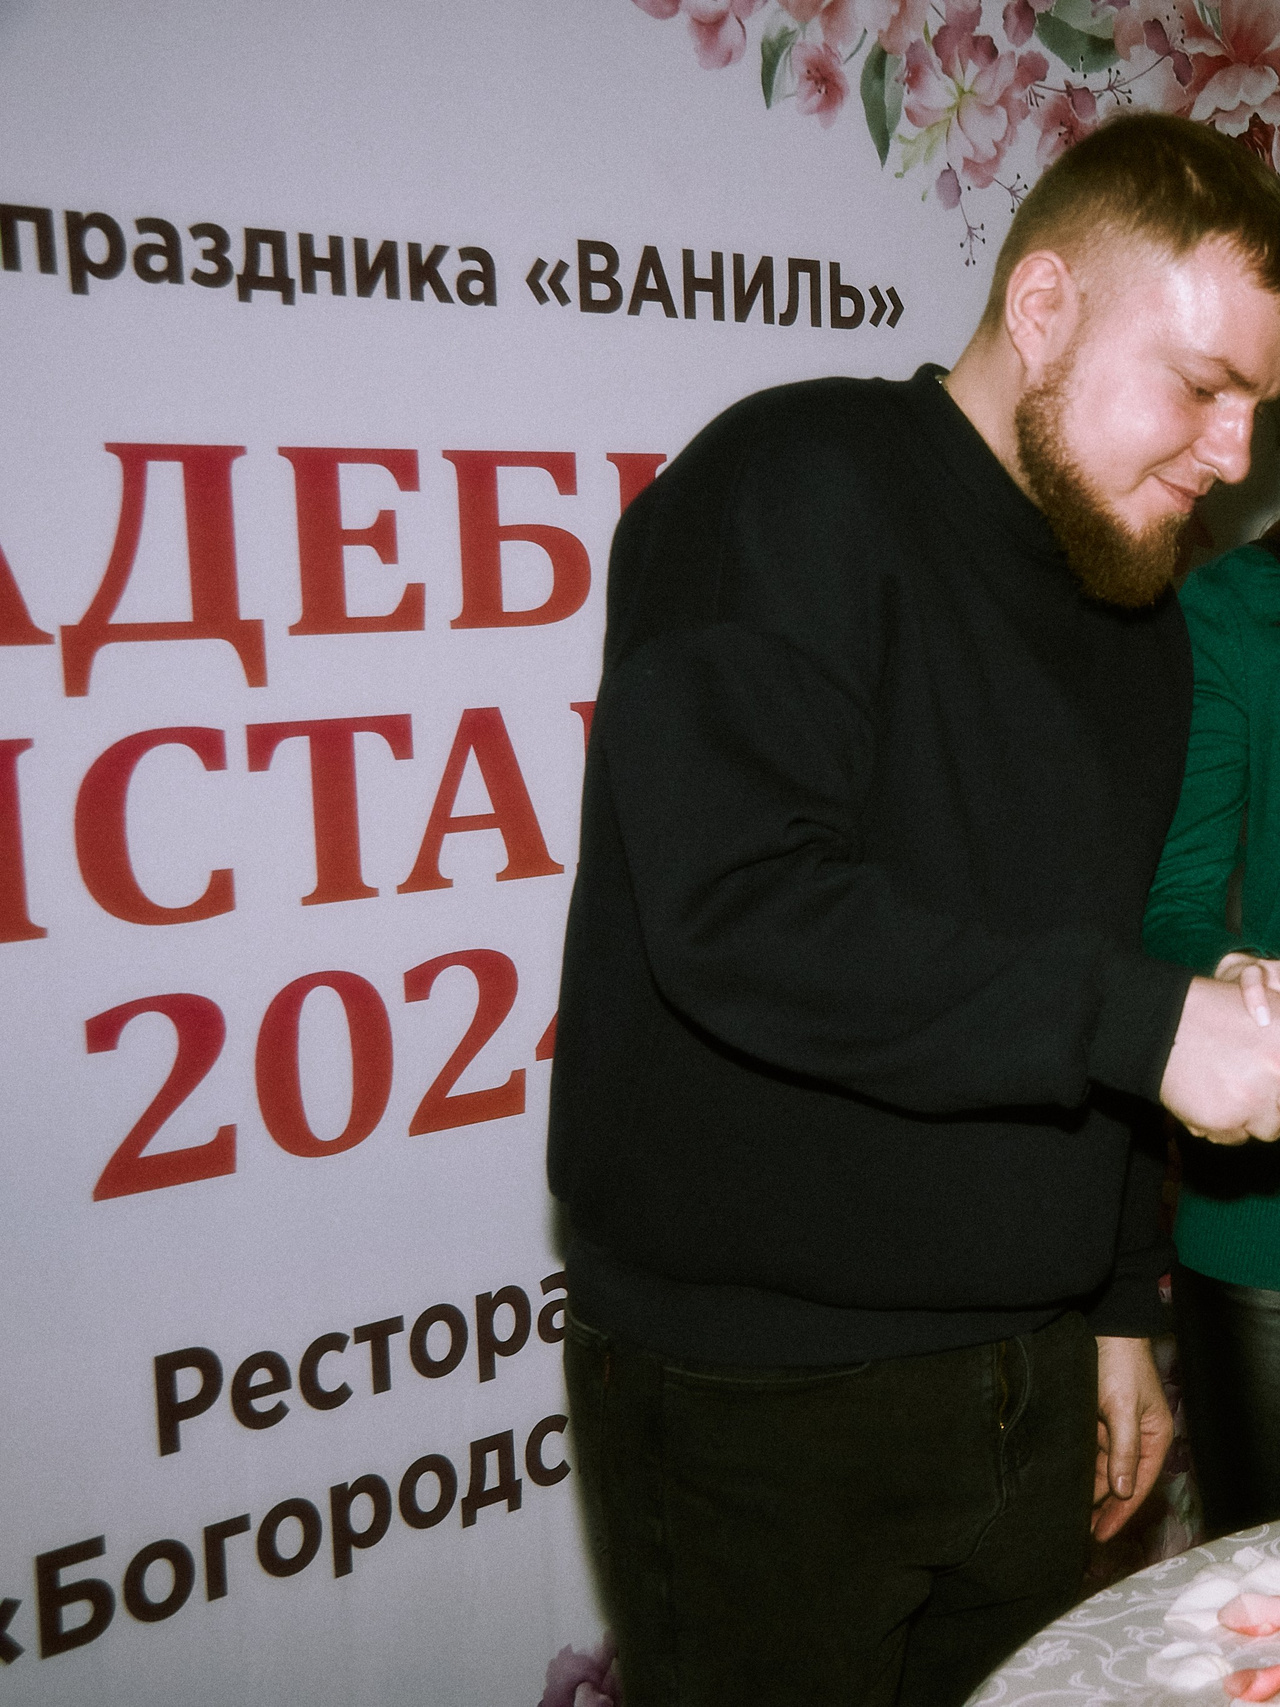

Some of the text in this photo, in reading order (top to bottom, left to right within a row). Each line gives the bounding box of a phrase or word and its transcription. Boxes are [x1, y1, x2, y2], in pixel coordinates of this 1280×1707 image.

[0, 203, 904, 330] праздника «ВАНИЛЬ»
[0, 700, 598, 944] СТА
[85, 947, 559, 1201] 202
